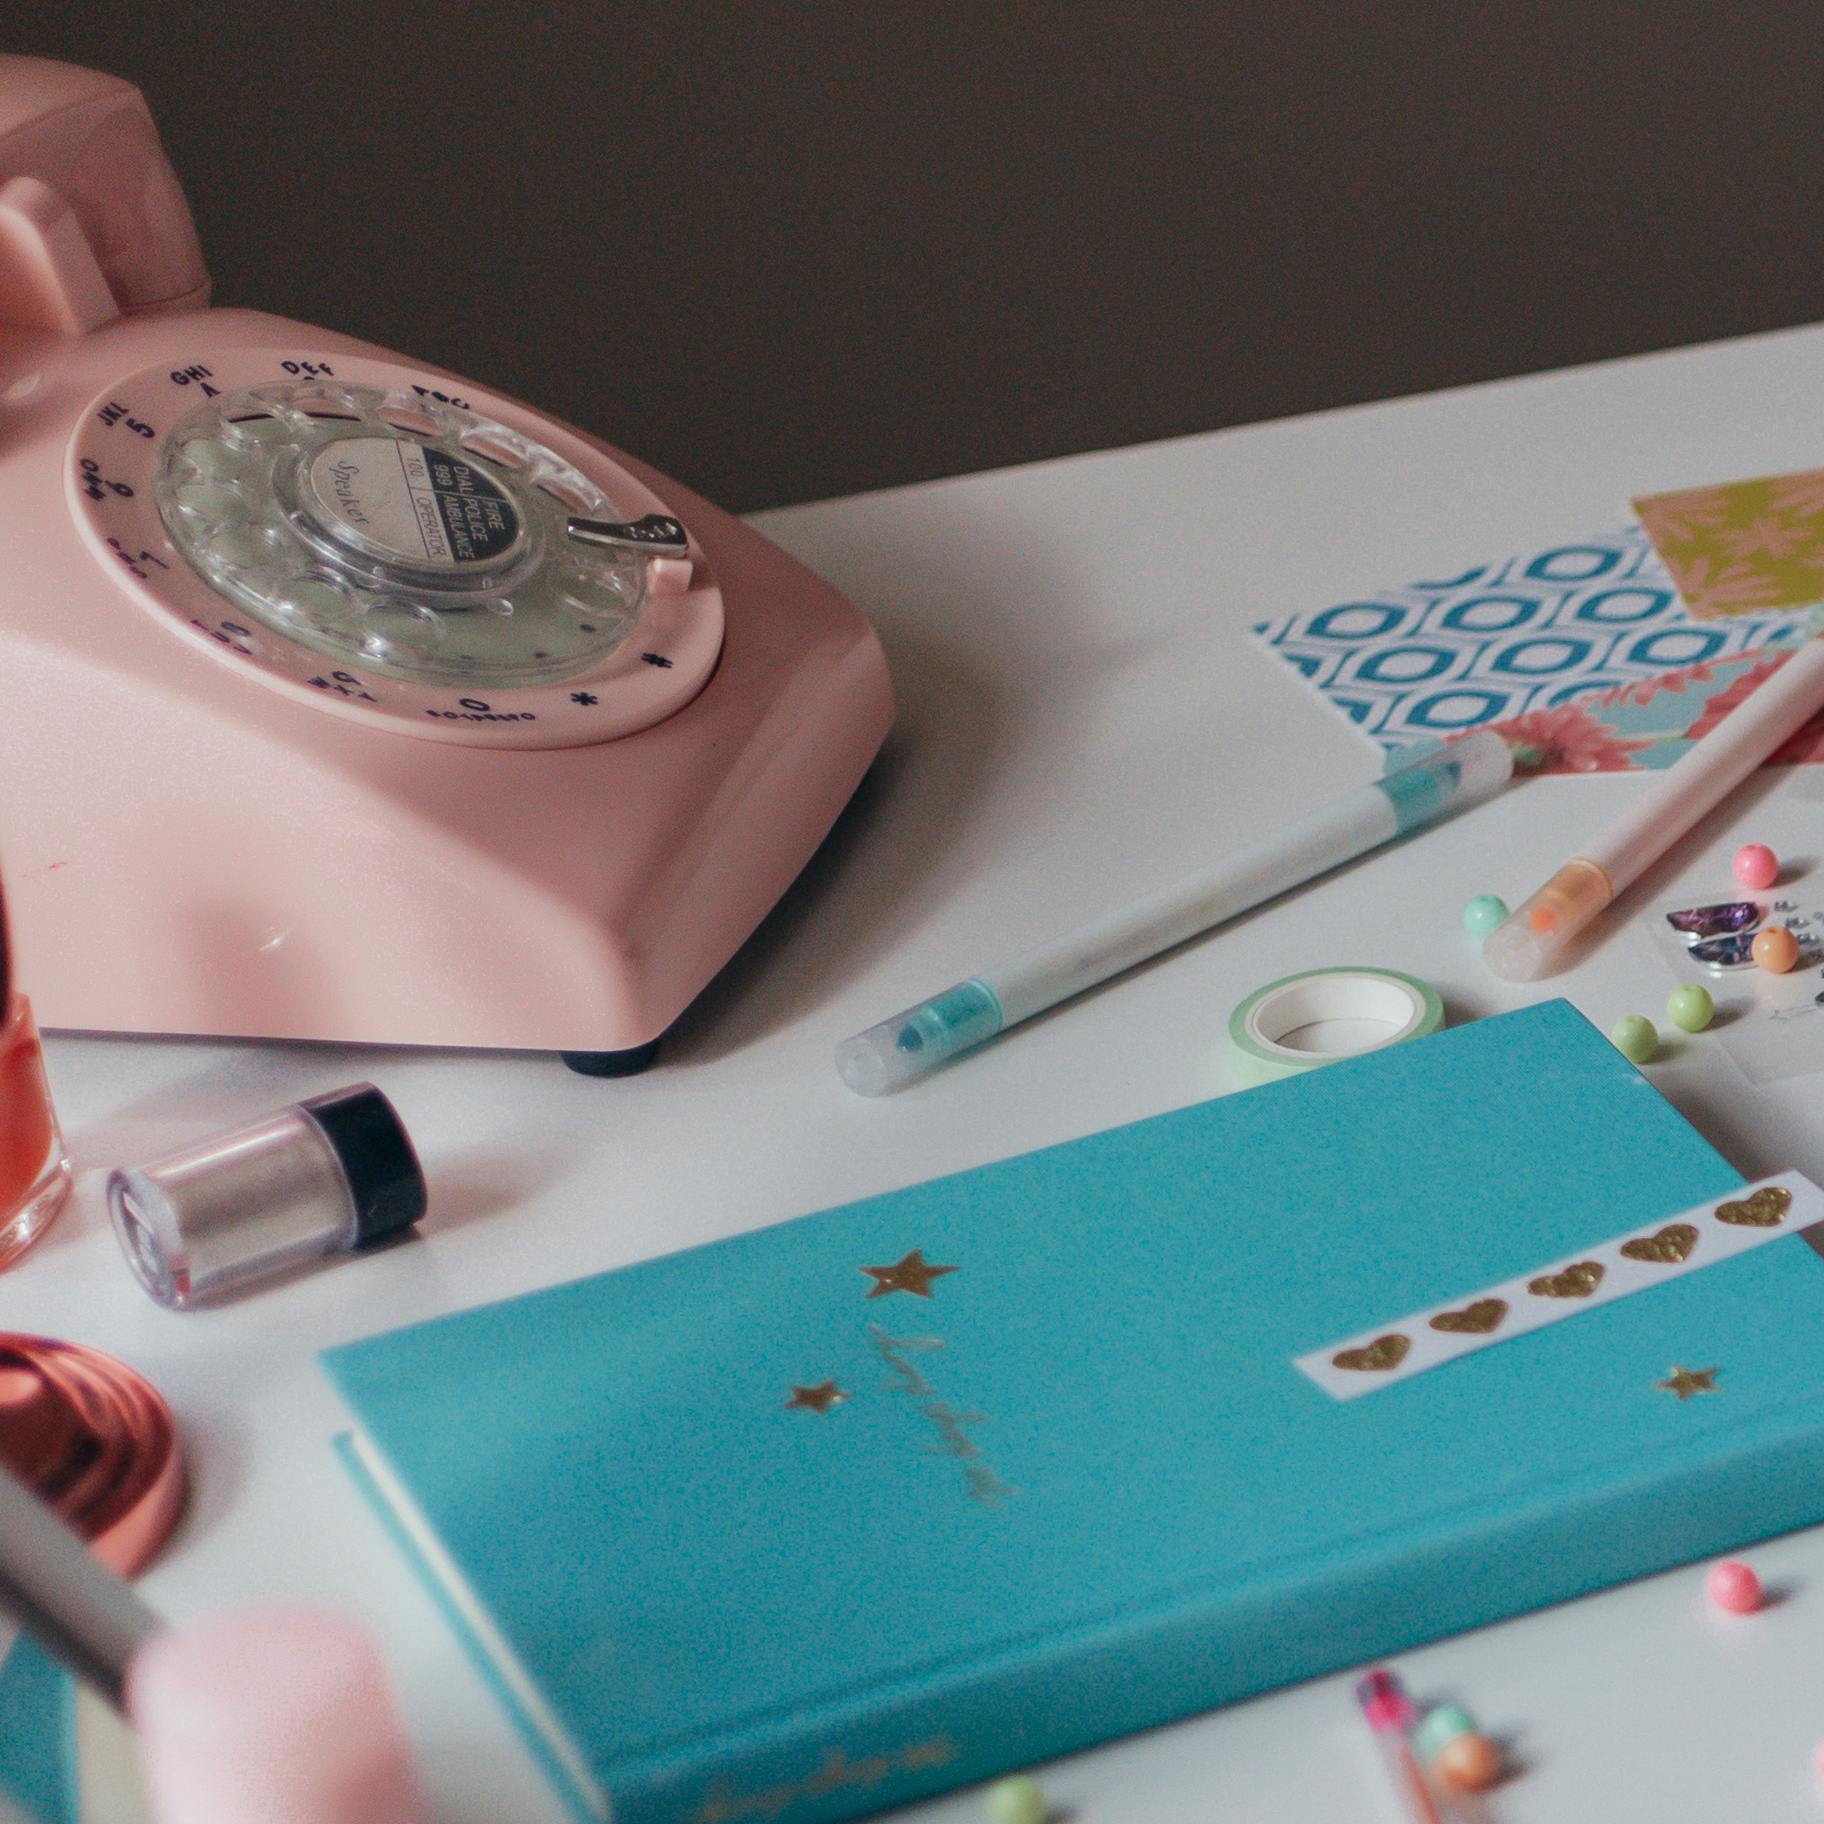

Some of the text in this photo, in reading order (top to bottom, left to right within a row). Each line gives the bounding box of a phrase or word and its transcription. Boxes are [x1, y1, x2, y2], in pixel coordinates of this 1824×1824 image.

[169, 364, 213, 386] GHI
[281, 360, 334, 376] DEF
[97, 402, 129, 427] JKL
[126, 417, 156, 439] 5
[328, 460, 370, 526] Speaker
[453, 465, 489, 542] DIAL POLICE
[406, 457, 447, 558] 100 OPERATOR
[433, 464, 475, 559] 999 AMBULANCE
[484, 500, 505, 531] FIRE
[458, 697, 490, 713] 0
